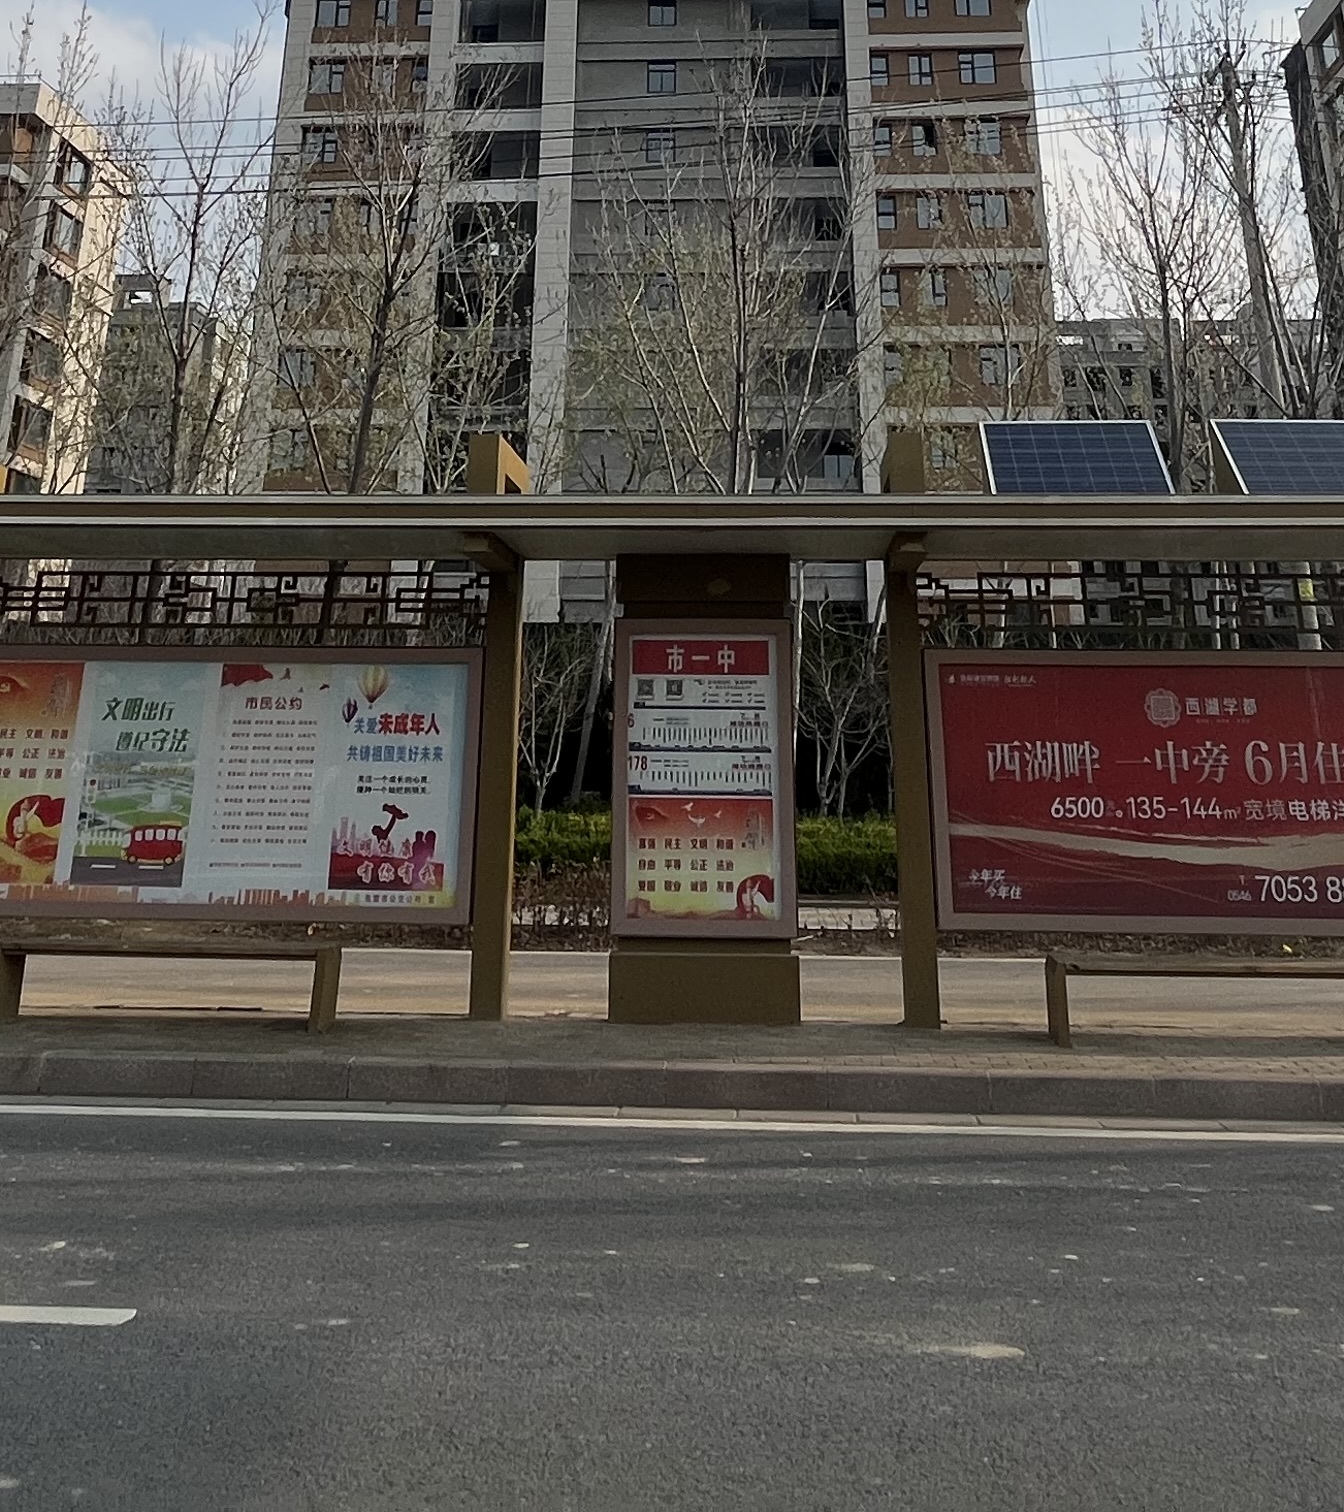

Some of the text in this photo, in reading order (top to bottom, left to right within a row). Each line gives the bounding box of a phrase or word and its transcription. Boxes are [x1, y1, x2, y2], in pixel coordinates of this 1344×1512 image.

[665, 643, 736, 674] 市一中
[101, 697, 176, 721] 文明出行
[244, 696, 303, 710] 市民公约
[1185, 696, 1258, 717] 西湖学都
[0, 728, 17, 740] 民主
[353, 712, 440, 736] 关爱未成年人
[115, 728, 192, 752] 遵纪守法
[22, 748, 41, 759] 公正
[346, 744, 444, 763] 共铸祖国美好未来
[627, 755, 649, 771] 178
[984, 739, 1101, 785] 西湖畔
[1115, 739, 1231, 785] 一中旁
[1050, 796, 1105, 819] 6500
[336, 838, 414, 859] 文明健康
[664, 838, 682, 850] 民主
[356, 861, 437, 885] 有你有我
[690, 859, 708, 871] 公正
[968, 868, 1006, 887] 今年买
[984, 885, 1023, 900] 今年住
[1227, 889, 1253, 902] 0546
[1255, 875, 1319, 903] 7053
